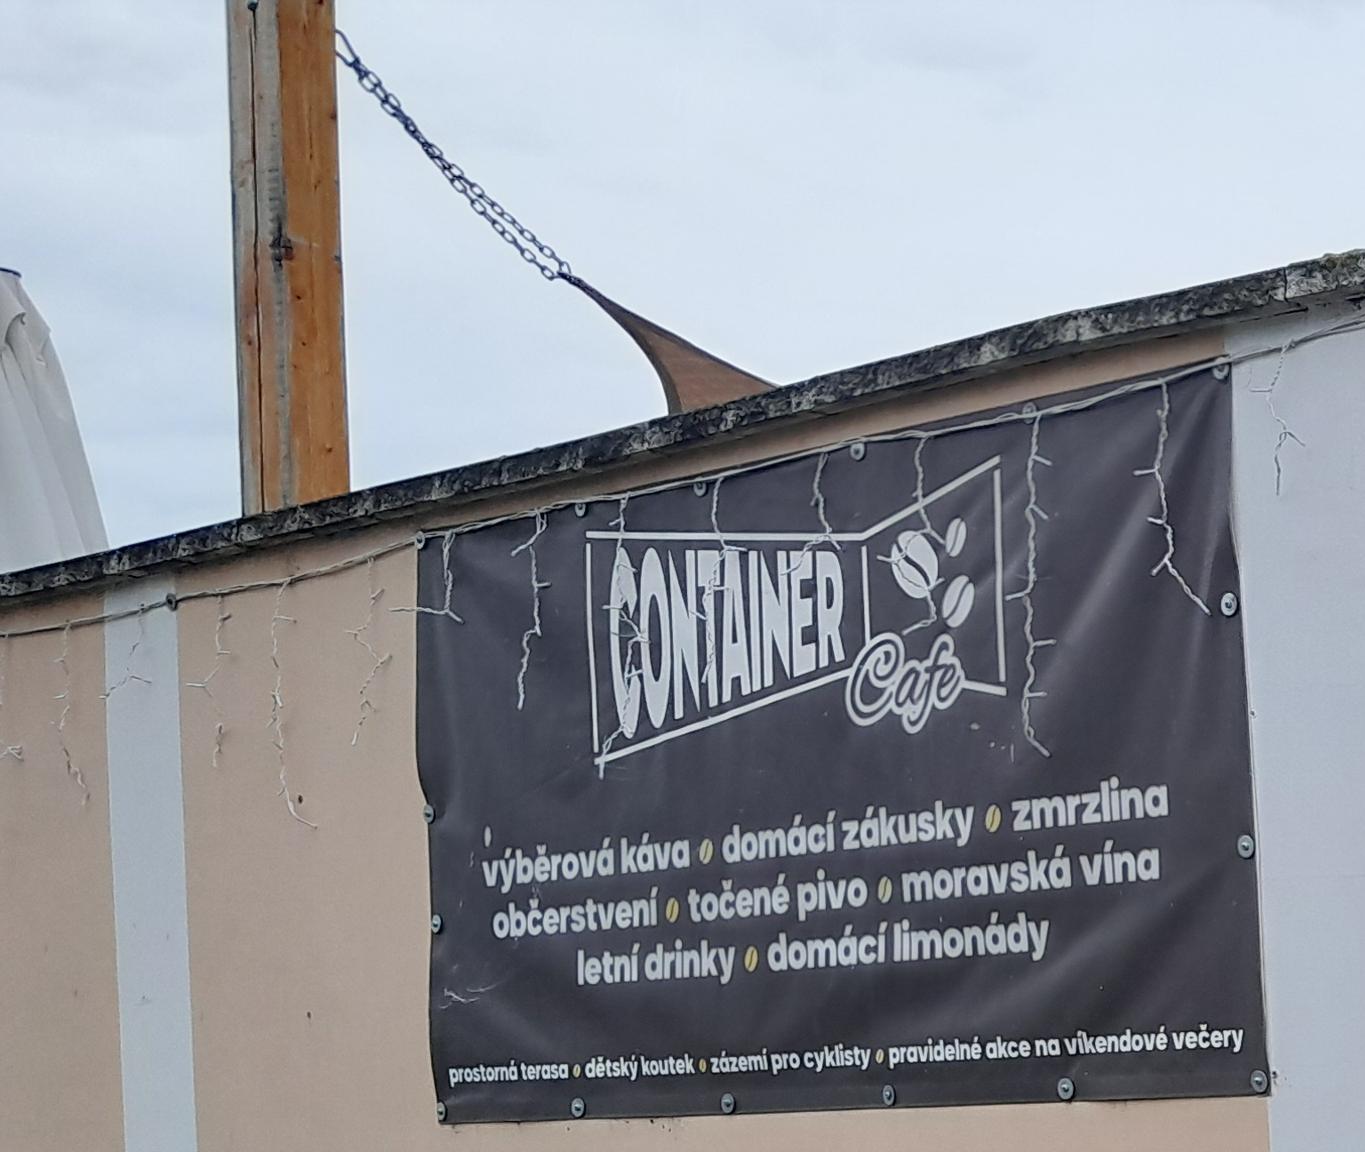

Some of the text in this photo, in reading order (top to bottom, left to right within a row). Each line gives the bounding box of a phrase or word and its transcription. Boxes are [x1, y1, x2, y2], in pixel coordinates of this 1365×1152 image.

[609, 547, 846, 739] CONTAINER
[846, 632, 966, 734] Cafe
[482, 775, 1170, 893] výběrová káva domácí zákusky zmrzlina
[492, 839, 1161, 939] občerstvení točené pivo moravská vína
[577, 911, 1050, 985] letní drinky domácí limonády
[448, 1023, 1244, 1088] prostorná terasa dětský koutek zázemí pro cyklisty pravidelné akce na víkendové večery
